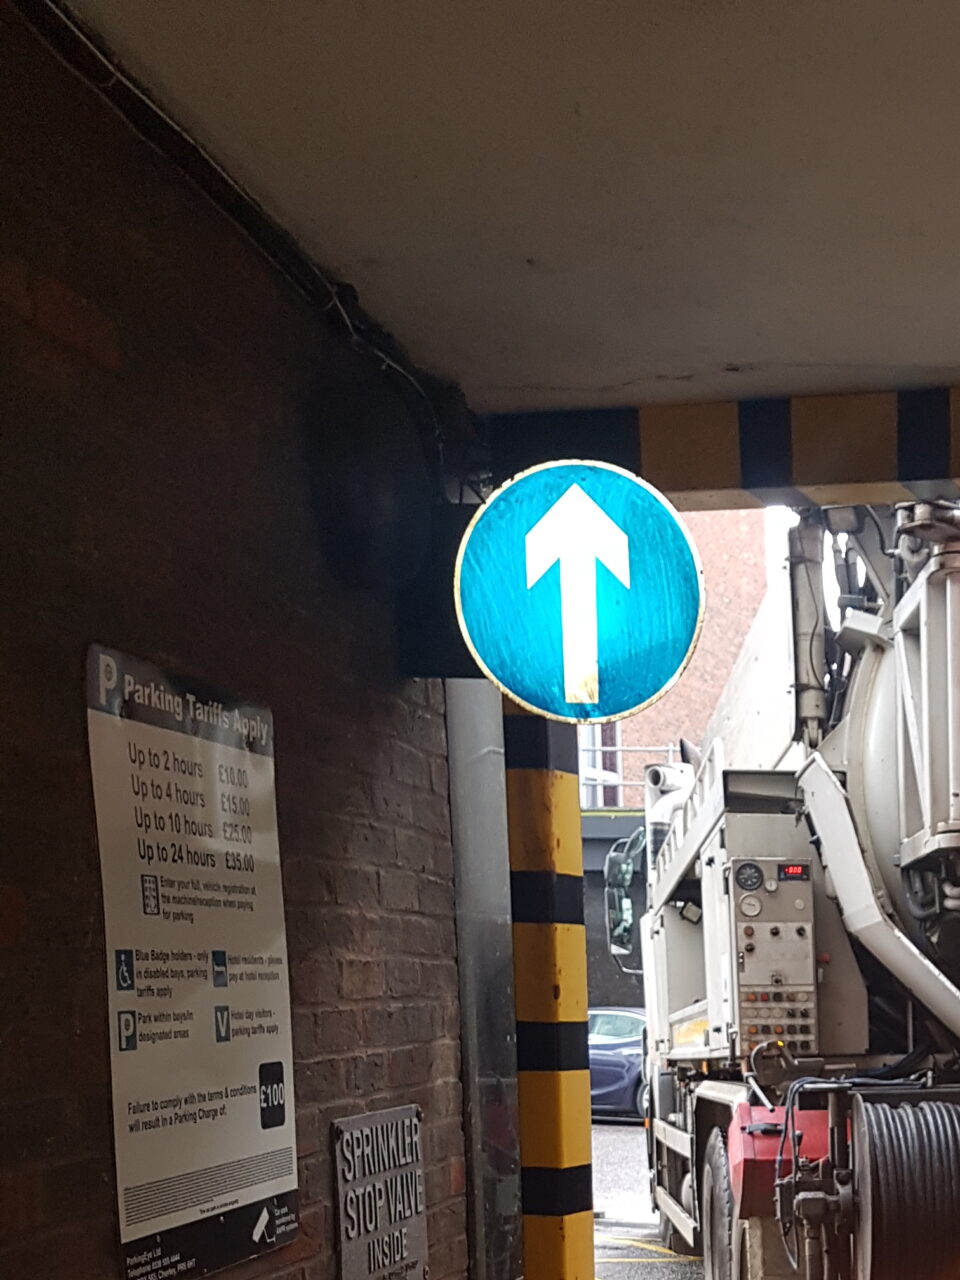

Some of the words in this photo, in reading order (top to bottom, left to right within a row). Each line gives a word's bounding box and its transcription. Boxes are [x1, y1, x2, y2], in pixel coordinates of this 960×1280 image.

[124, 674, 183, 721] Parking
[186, 693, 229, 729] Tariffs
[233, 708, 268, 746] Apply
[128, 741, 145, 770] Up
[148, 748, 160, 769] to
[163, 750, 170, 771] 2
[173, 752, 203, 778] hours
[218, 764, 248, 788] £10.00
[131, 774, 148, 802] Up
[151, 779, 162, 800] to
[166, 782, 172, 801] 4
[175, 782, 205, 808] hours
[221, 793, 250, 816] £15.00
[134, 806, 151, 833] Up
[154, 811, 165, 831] to
[169, 812, 181, 834] 10
[184, 814, 213, 838] hours
[223, 822, 252, 844] £25.00
[137, 838, 154, 866] Up
[157, 842, 168, 863] to
[171, 843, 184, 864] 24
[186, 845, 215, 868] hours
[225, 850, 254, 873] £35.00
[172, 911, 194, 924] parking
[135, 949, 149, 961] Blue
[151, 949, 169, 964] Badge
[171, 950, 192, 961] holders
[136, 968, 142, 979] in
[144, 967, 169, 979] disabled
[187, 968, 208, 980] parking
[137, 985, 155, 997] tariffs
[156, 985, 172, 999] apply
[138, 1012, 152, 1024] Park
[127, 1100, 150, 1115] Failure
[151, 1099, 158, 1111] to
[159, 1095, 183, 1110] comply
[183, 1094, 197, 1106] with
[197, 1091, 206, 1103] the
[207, 1090, 224, 1101] terms
[230, 1083, 257, 1098] conditions
[260, 1082, 285, 1108] £100
[128, 1119, 141, 1133] will
[141, 1117, 160, 1131] result
[161, 1115, 168, 1127] in
[168, 1116, 173, 1126] a
[174, 1110, 197, 1124] Parking
[197, 1106, 218, 1121] Charge
[342, 1117, 421, 1182] SPRINKLER
[345, 1182, 385, 1240] STOP
[385, 1168, 424, 1225] VALVE
[368, 1227, 409, 1274] INSIDE
